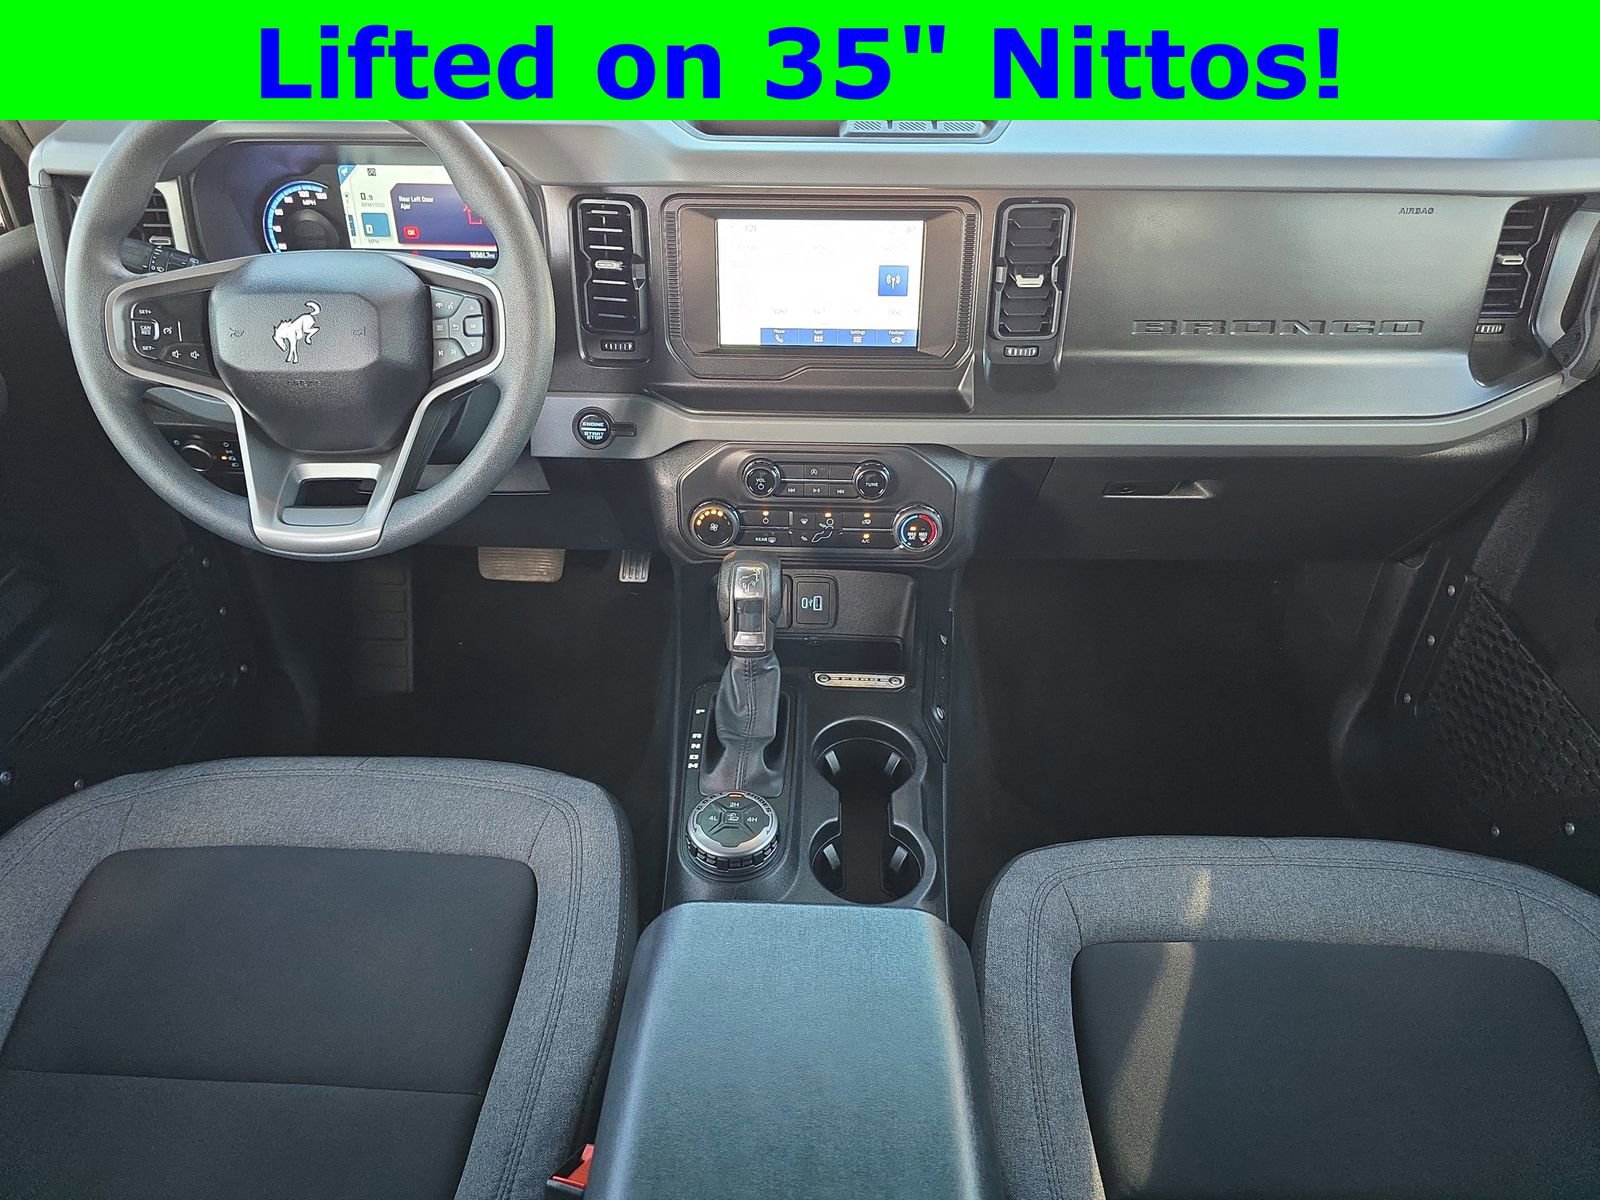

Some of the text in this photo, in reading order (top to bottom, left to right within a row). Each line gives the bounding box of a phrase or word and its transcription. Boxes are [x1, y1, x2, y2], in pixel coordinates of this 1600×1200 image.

[410, 195, 422, 203] Left
[421, 195, 434, 203] Door
[1398, 207, 1434, 215] AIRBAG
[1131, 319, 1424, 336] BRONCO
